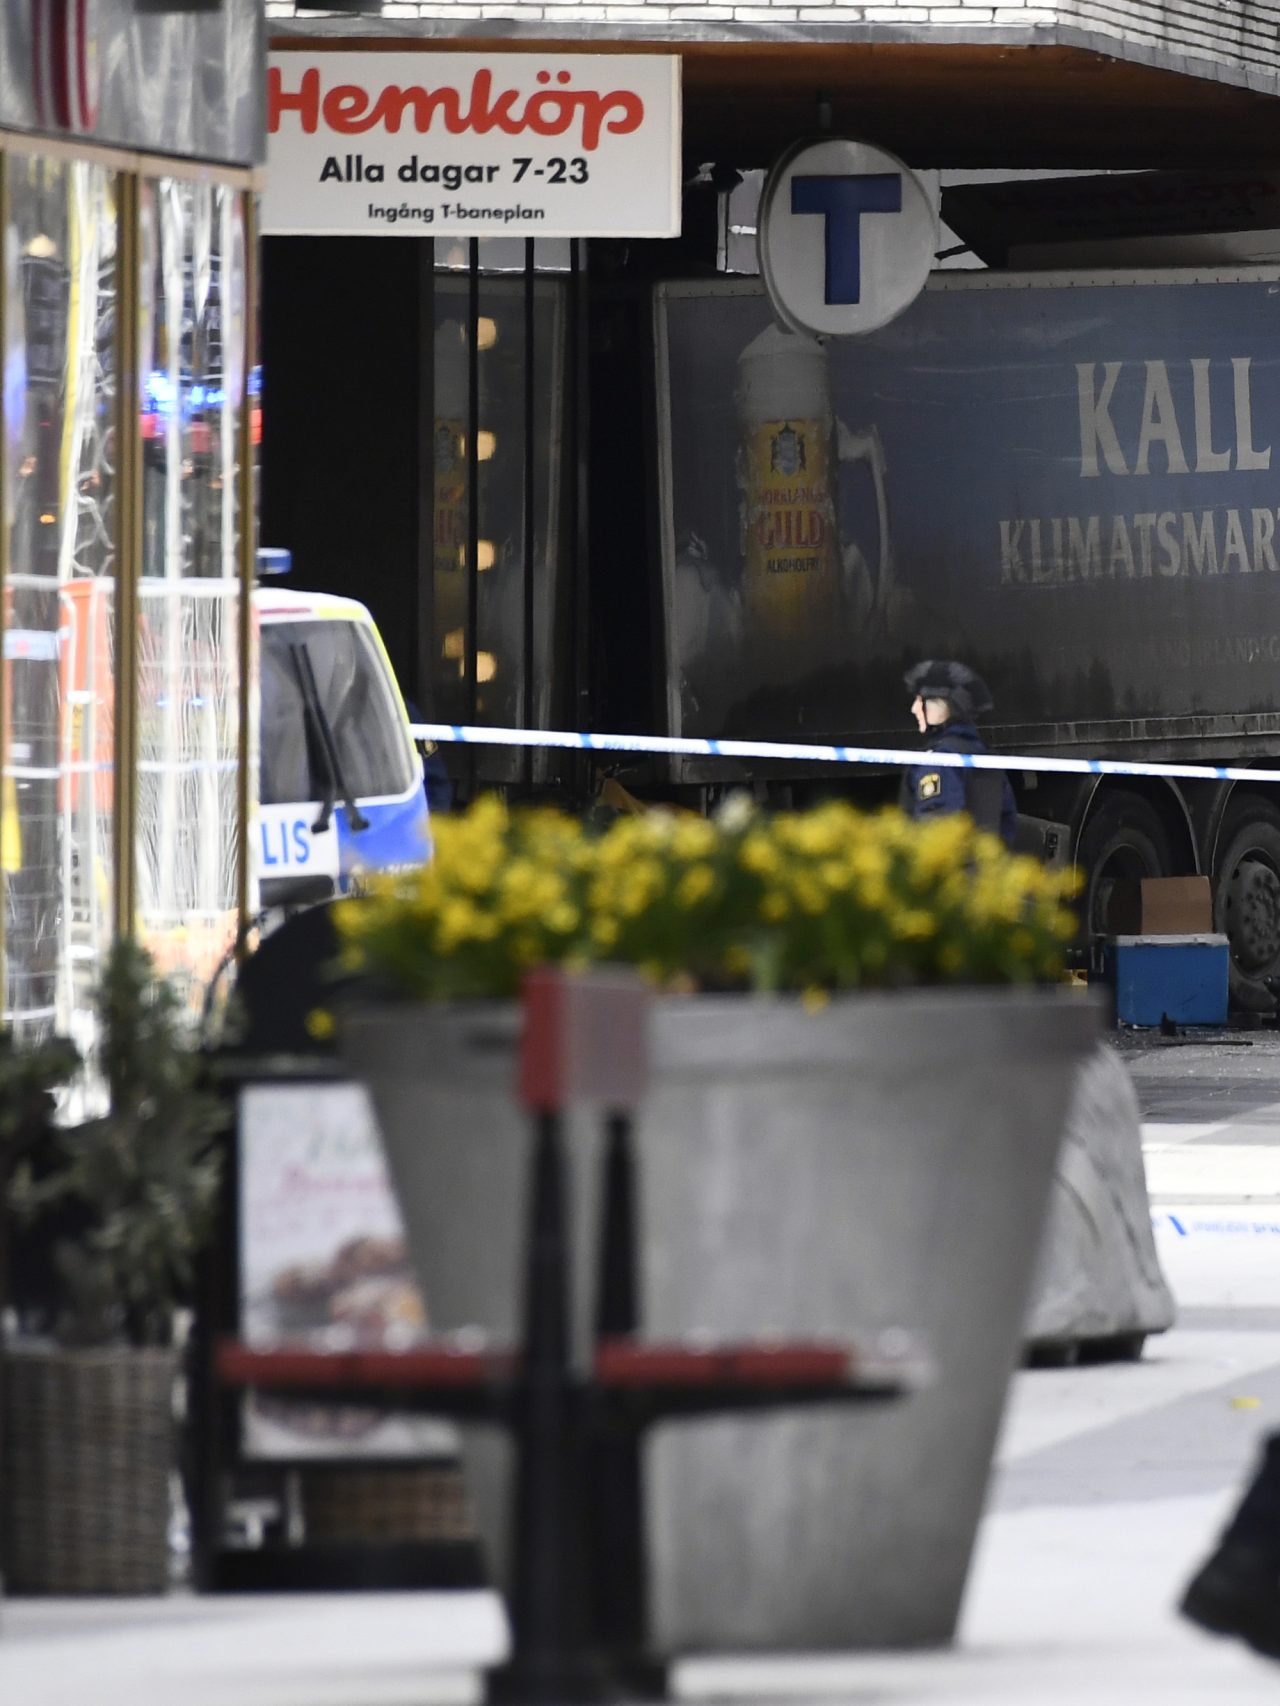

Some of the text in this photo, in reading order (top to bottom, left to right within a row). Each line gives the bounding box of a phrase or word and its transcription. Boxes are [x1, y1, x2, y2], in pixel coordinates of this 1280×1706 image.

[266, 67, 645, 151] Hemköp
[319, 155, 590, 190] Alla dagar 7-23
[367, 202, 545, 224] Ingång T-baneplan
[791, 173, 902, 305] T
[1075, 357, 1272, 478] KALL
[260, 820, 311, 865] LIS
